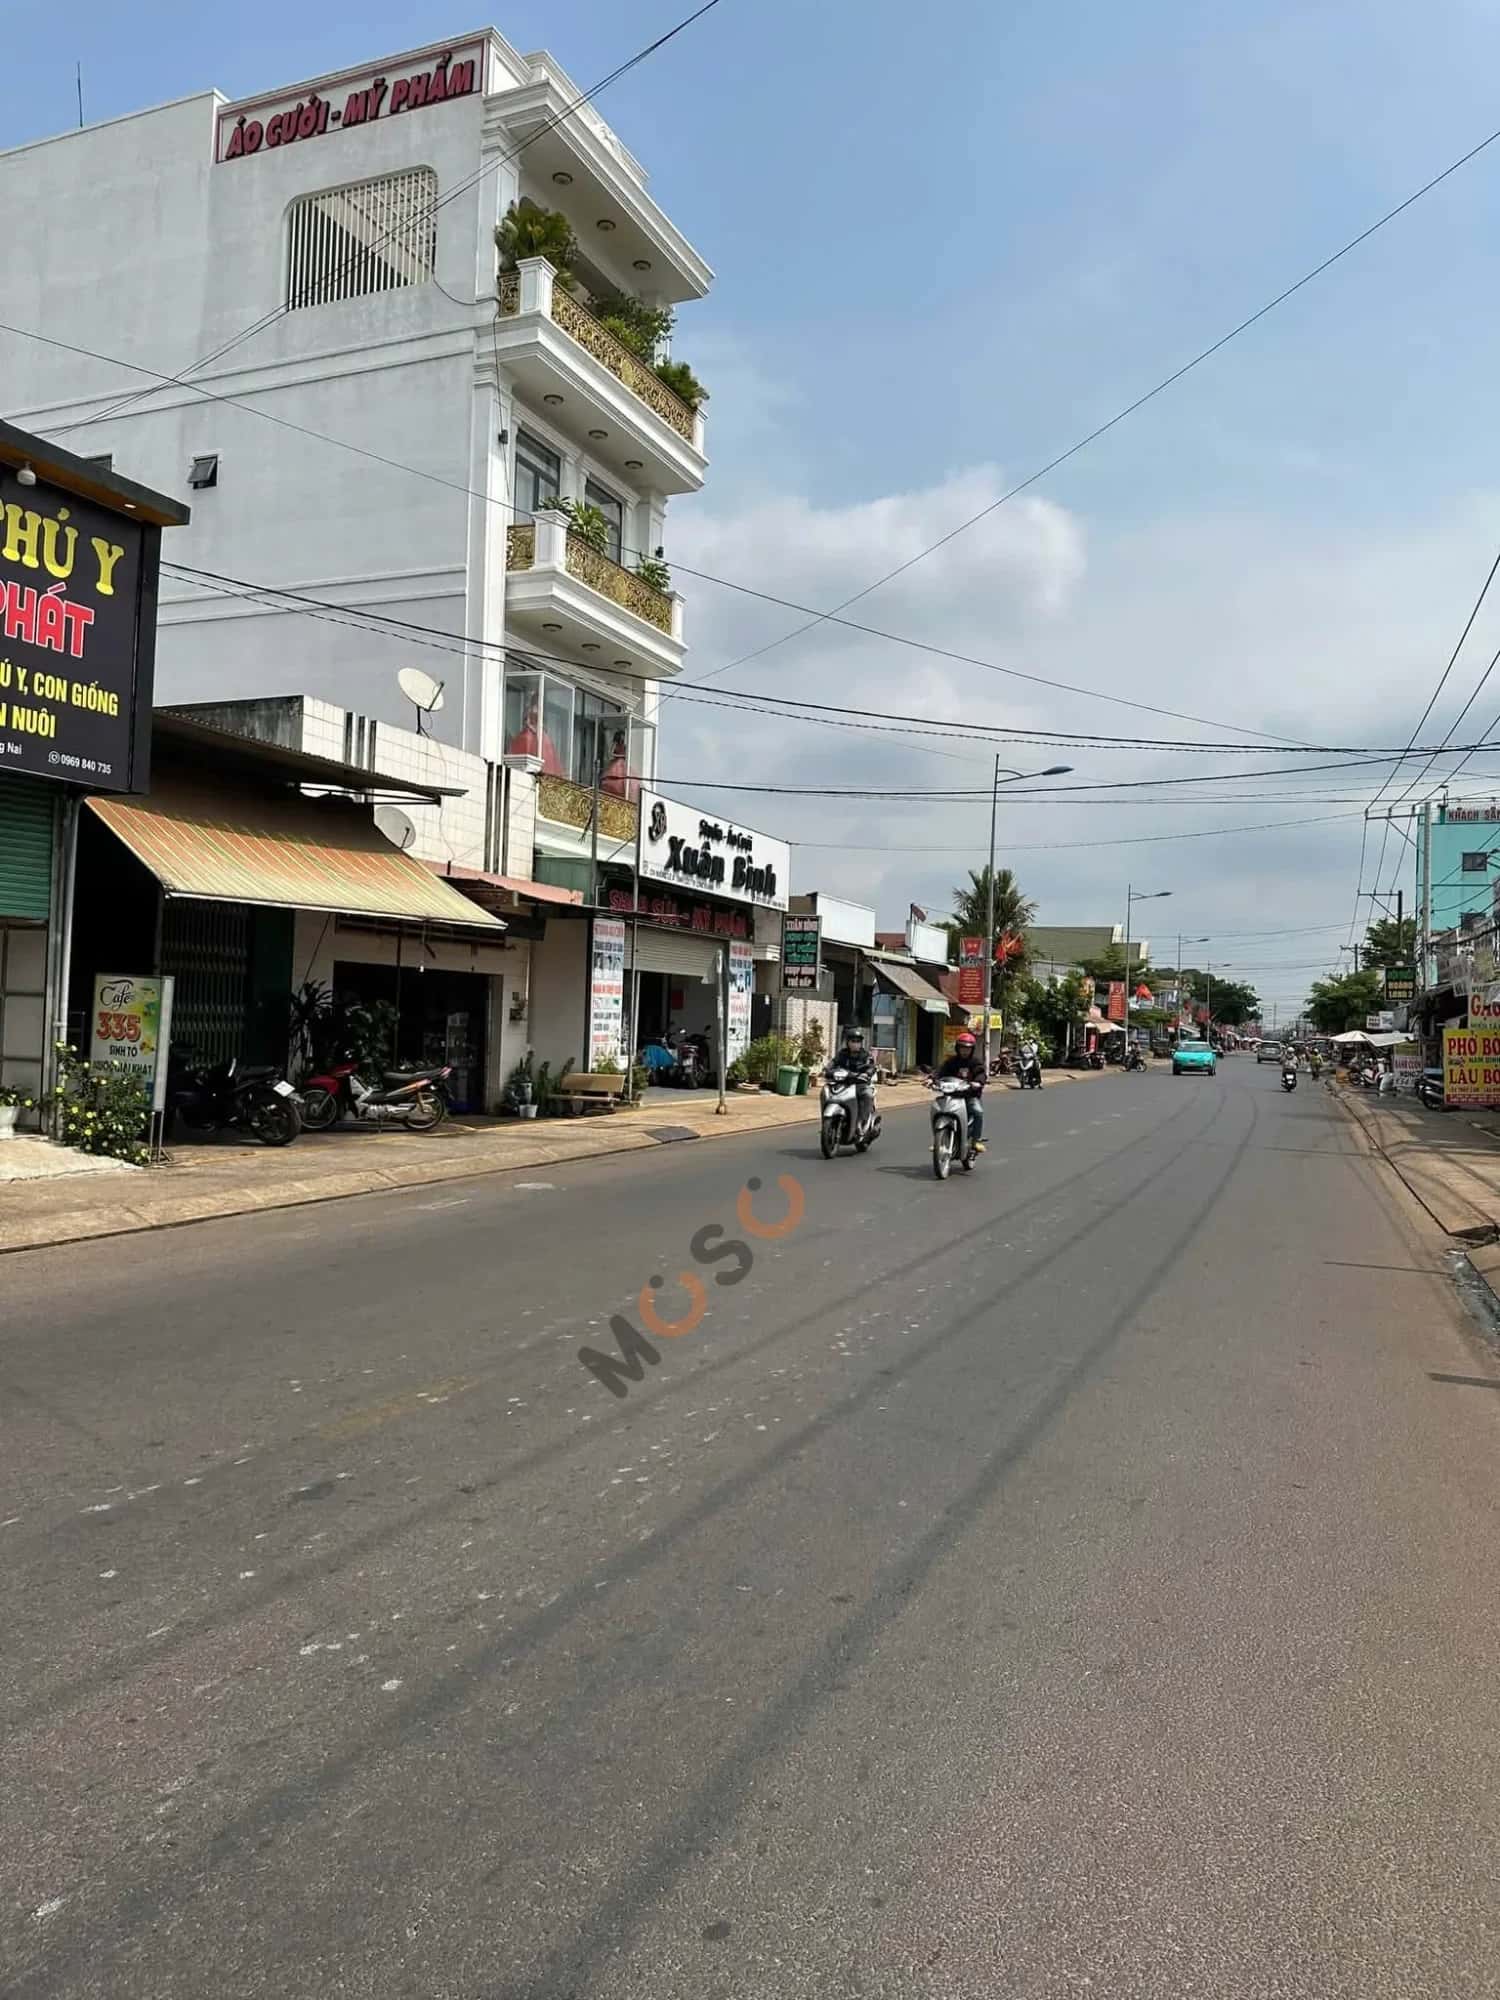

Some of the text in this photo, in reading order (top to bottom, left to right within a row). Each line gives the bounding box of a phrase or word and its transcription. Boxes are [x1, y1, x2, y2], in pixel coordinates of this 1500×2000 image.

[342, 77, 388, 127] MỸ
[390, 51, 474, 113] PHẨM
[91, 537, 124, 595] Y
[0, 581, 95, 658] HÁT
[33, 671, 67, 703] CON
[71, 681, 119, 716] GIỐNG
[12, 705, 56, 738] NUÔI
[7, 742, 22, 755] Nai
[61, 754, 80, 769] 0969
[664, 834, 725, 882] Xuân
[731, 854, 776, 898] Bình
[96, 1010, 141, 1043] 335
[1447, 1030, 1478, 1056] PHỞ
